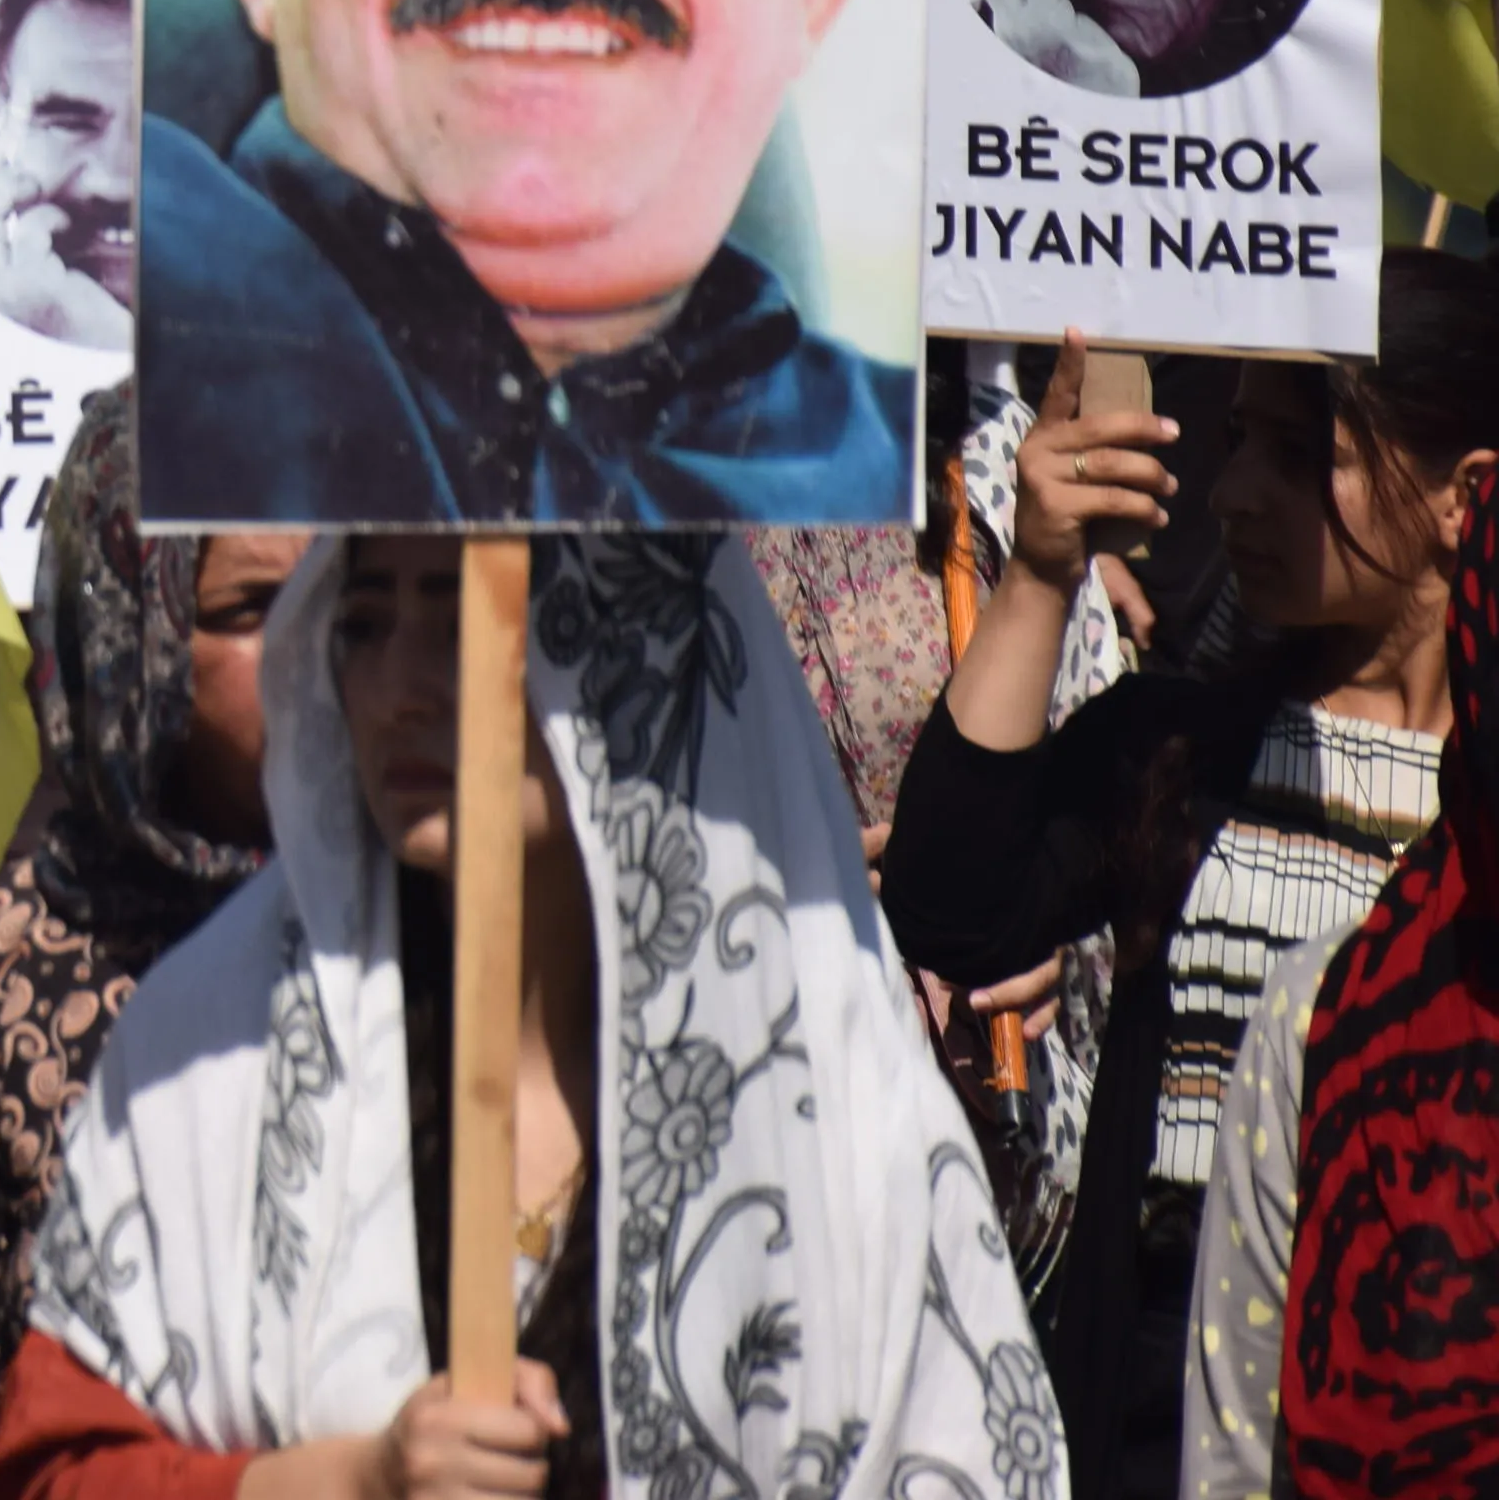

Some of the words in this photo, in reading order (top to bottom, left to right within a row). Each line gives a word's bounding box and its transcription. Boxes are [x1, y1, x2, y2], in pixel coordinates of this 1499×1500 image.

[966, 116, 1060, 182] BÊ
[1080, 130, 1323, 197] SEROK
[931, 204, 1123, 267] JIYAN
[1150, 218, 1340, 280] NABE
